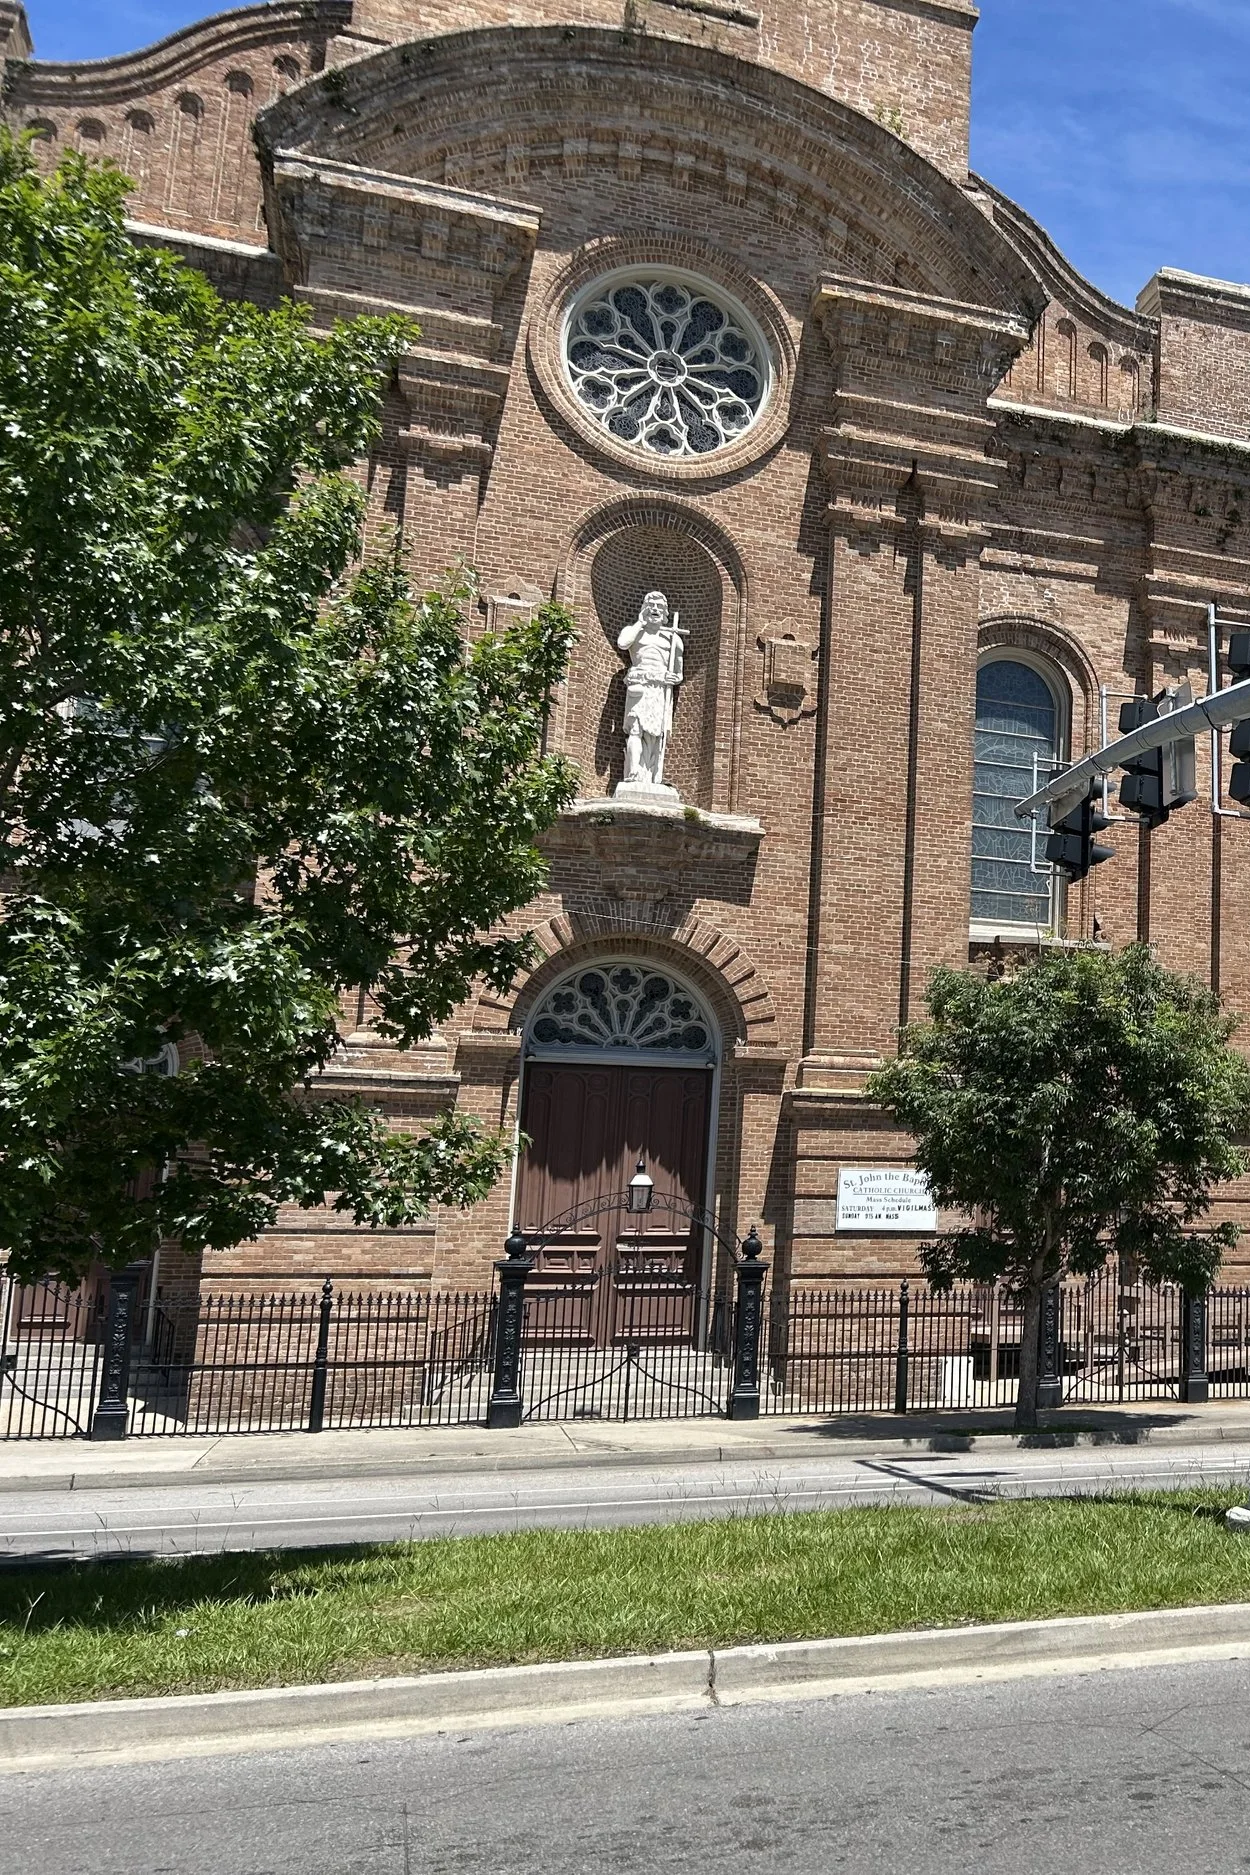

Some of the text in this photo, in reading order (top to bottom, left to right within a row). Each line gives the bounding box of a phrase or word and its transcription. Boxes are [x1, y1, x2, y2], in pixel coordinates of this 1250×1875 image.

[843, 1179, 857, 1189] St.
[859, 1173, 882, 1186] John
[884, 1172, 900, 1181] the
[852, 1186, 892, 1194] CATHOLIC
